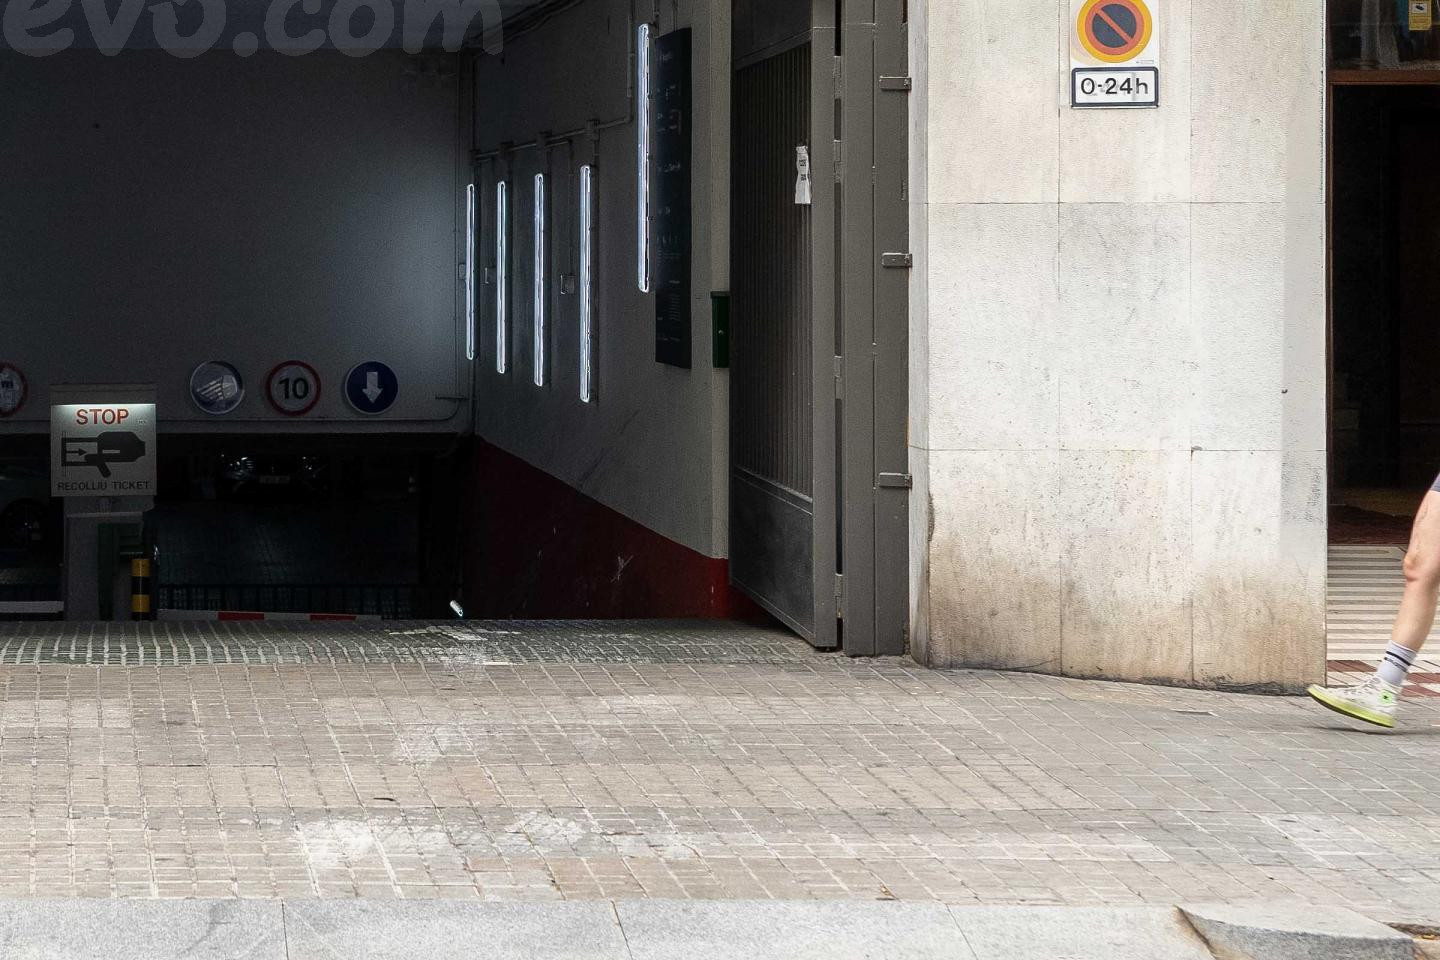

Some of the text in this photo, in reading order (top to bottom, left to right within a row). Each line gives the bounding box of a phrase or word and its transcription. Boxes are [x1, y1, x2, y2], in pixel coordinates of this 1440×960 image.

[1080, 77, 1149, 95] 0-24h
[277, 377, 310, 400] 10
[76, 408, 130, 426] STOP
[111, 480, 150, 490] TICKET
